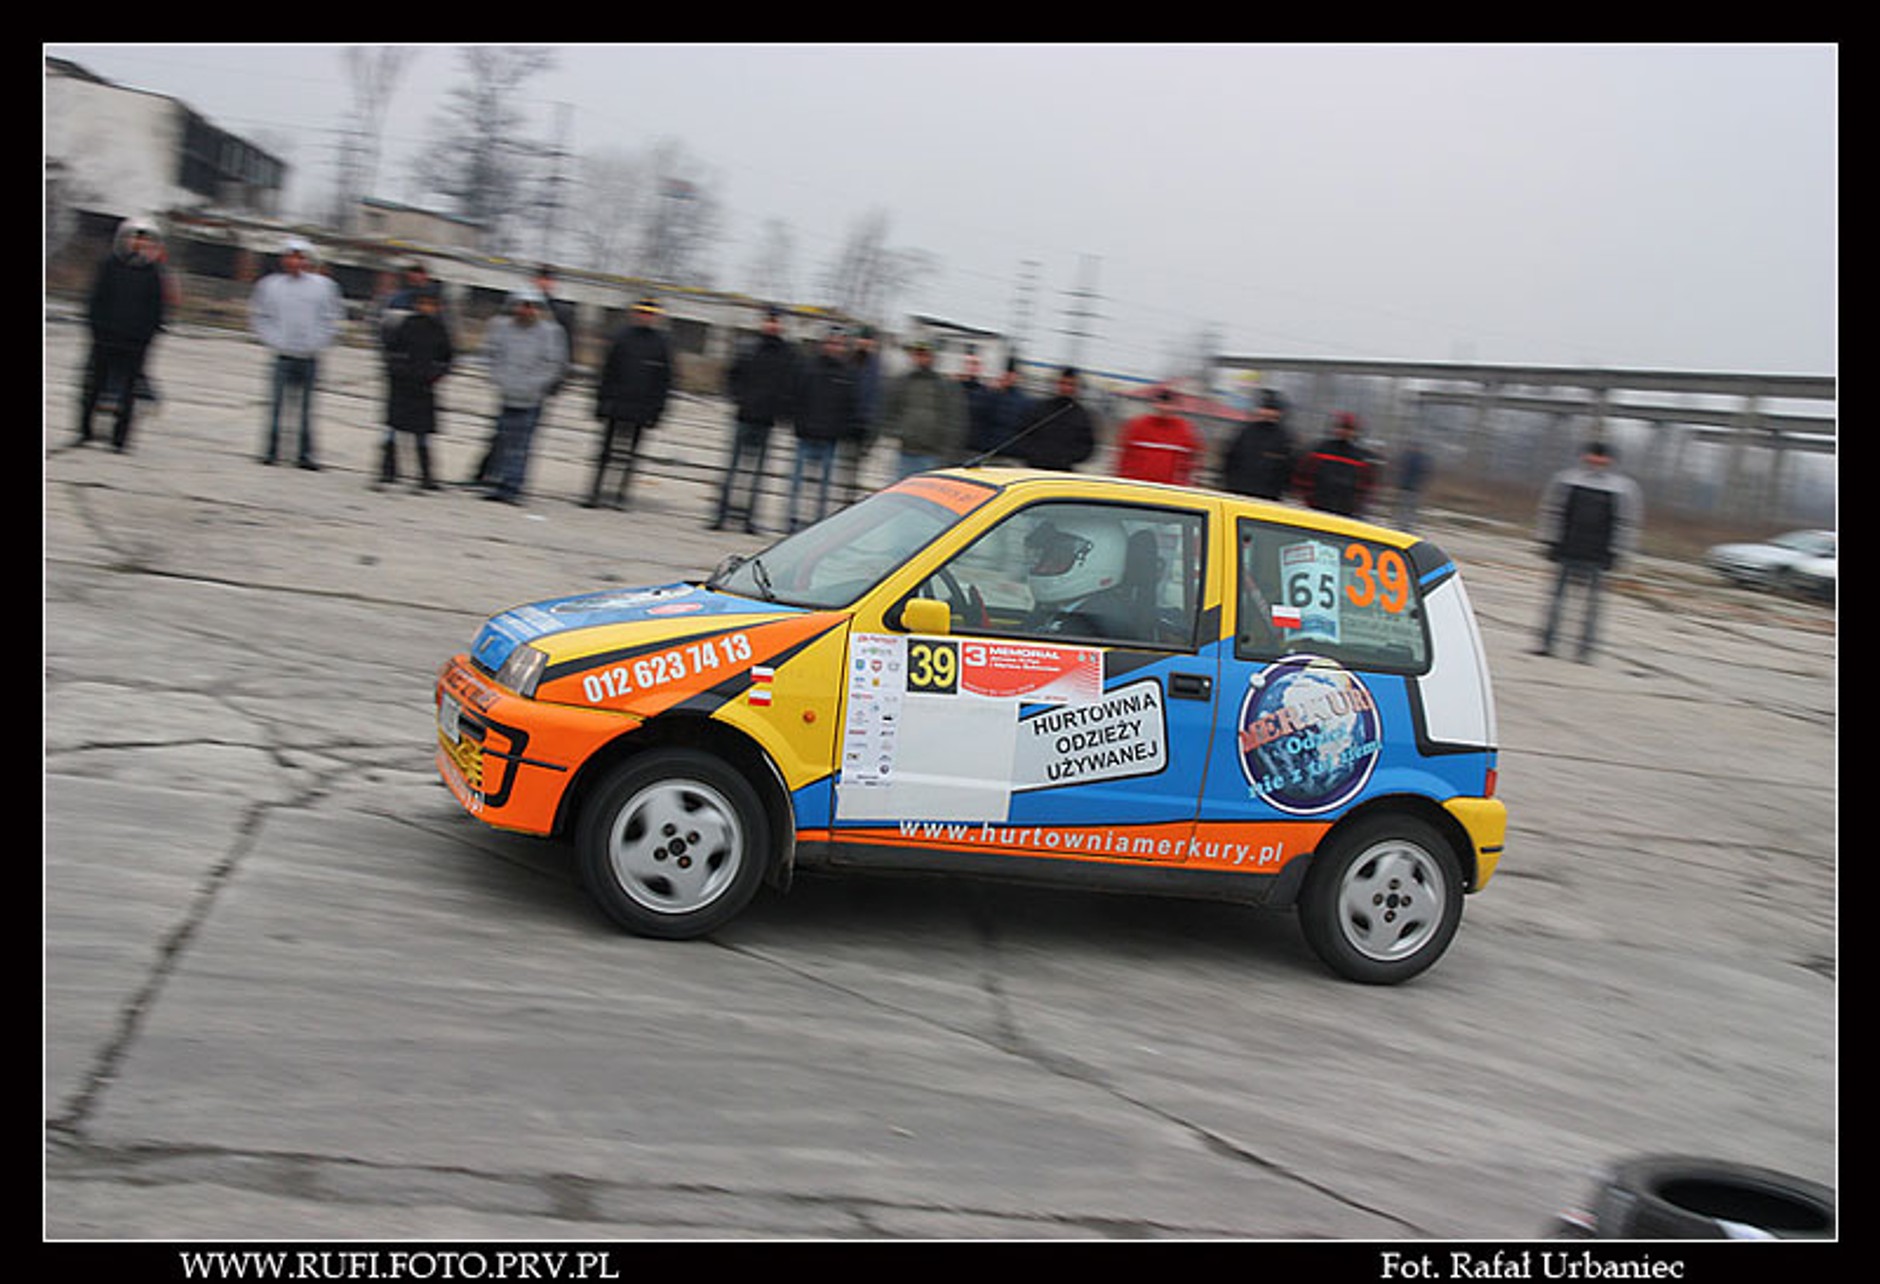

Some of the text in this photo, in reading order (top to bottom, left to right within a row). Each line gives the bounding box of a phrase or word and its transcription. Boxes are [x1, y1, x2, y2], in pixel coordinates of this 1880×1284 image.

[1288, 571, 1335, 610] 65
[1343, 543, 1409, 614] 39
[582, 633, 753, 704] 012 623 74 13
[909, 644, 957, 689] 39
[964, 645, 988, 668] 3
[1033, 693, 1158, 735] HURTOWNIA
[1055, 719, 1142, 754] ODZIEŻY
[1046, 740, 1158, 781] UŻYWANEJ
[899, 819, 1284, 863] www.hurtowniamerkury.pl
